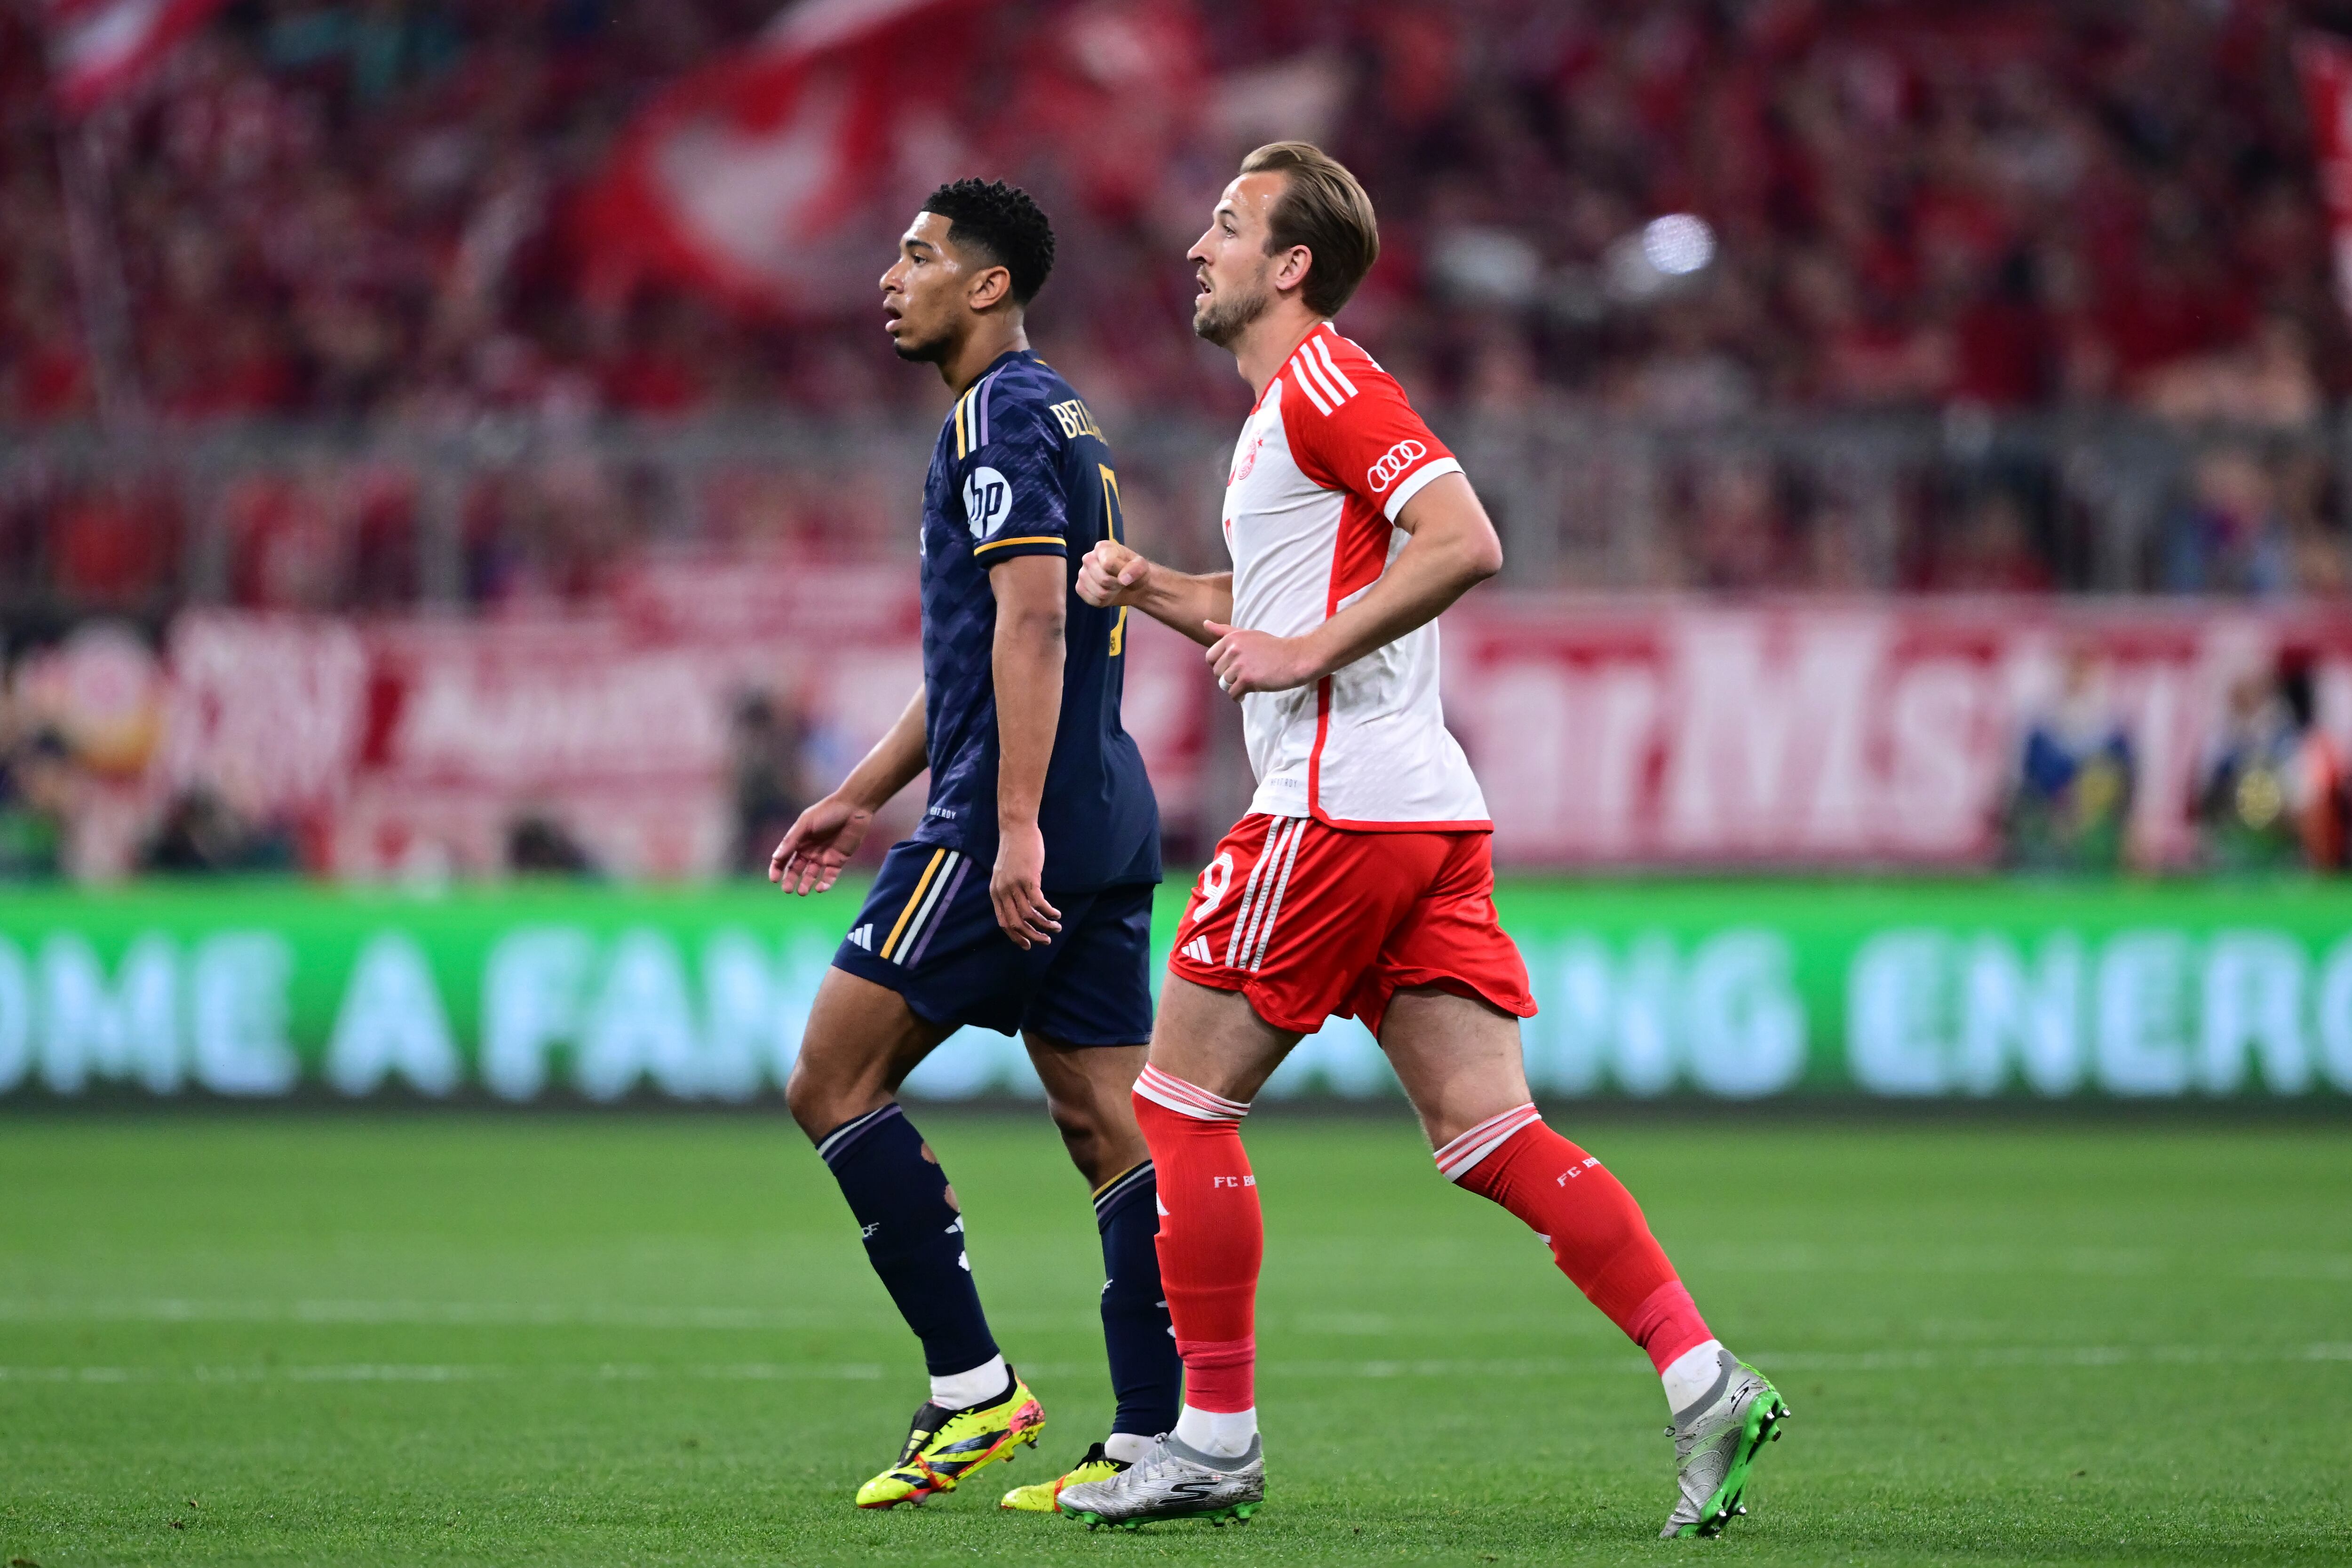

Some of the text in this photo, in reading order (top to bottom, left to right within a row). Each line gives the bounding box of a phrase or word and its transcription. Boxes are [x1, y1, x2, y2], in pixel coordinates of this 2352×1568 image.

[970, 469, 1004, 538] hp
[1192, 852, 1234, 923] 9
[323, 926, 462, 1098] A
[1846, 927, 2352, 1098] ENER
[1214, 1176, 1238, 1188] FC
[1557, 1166, 1581, 1187] FC
